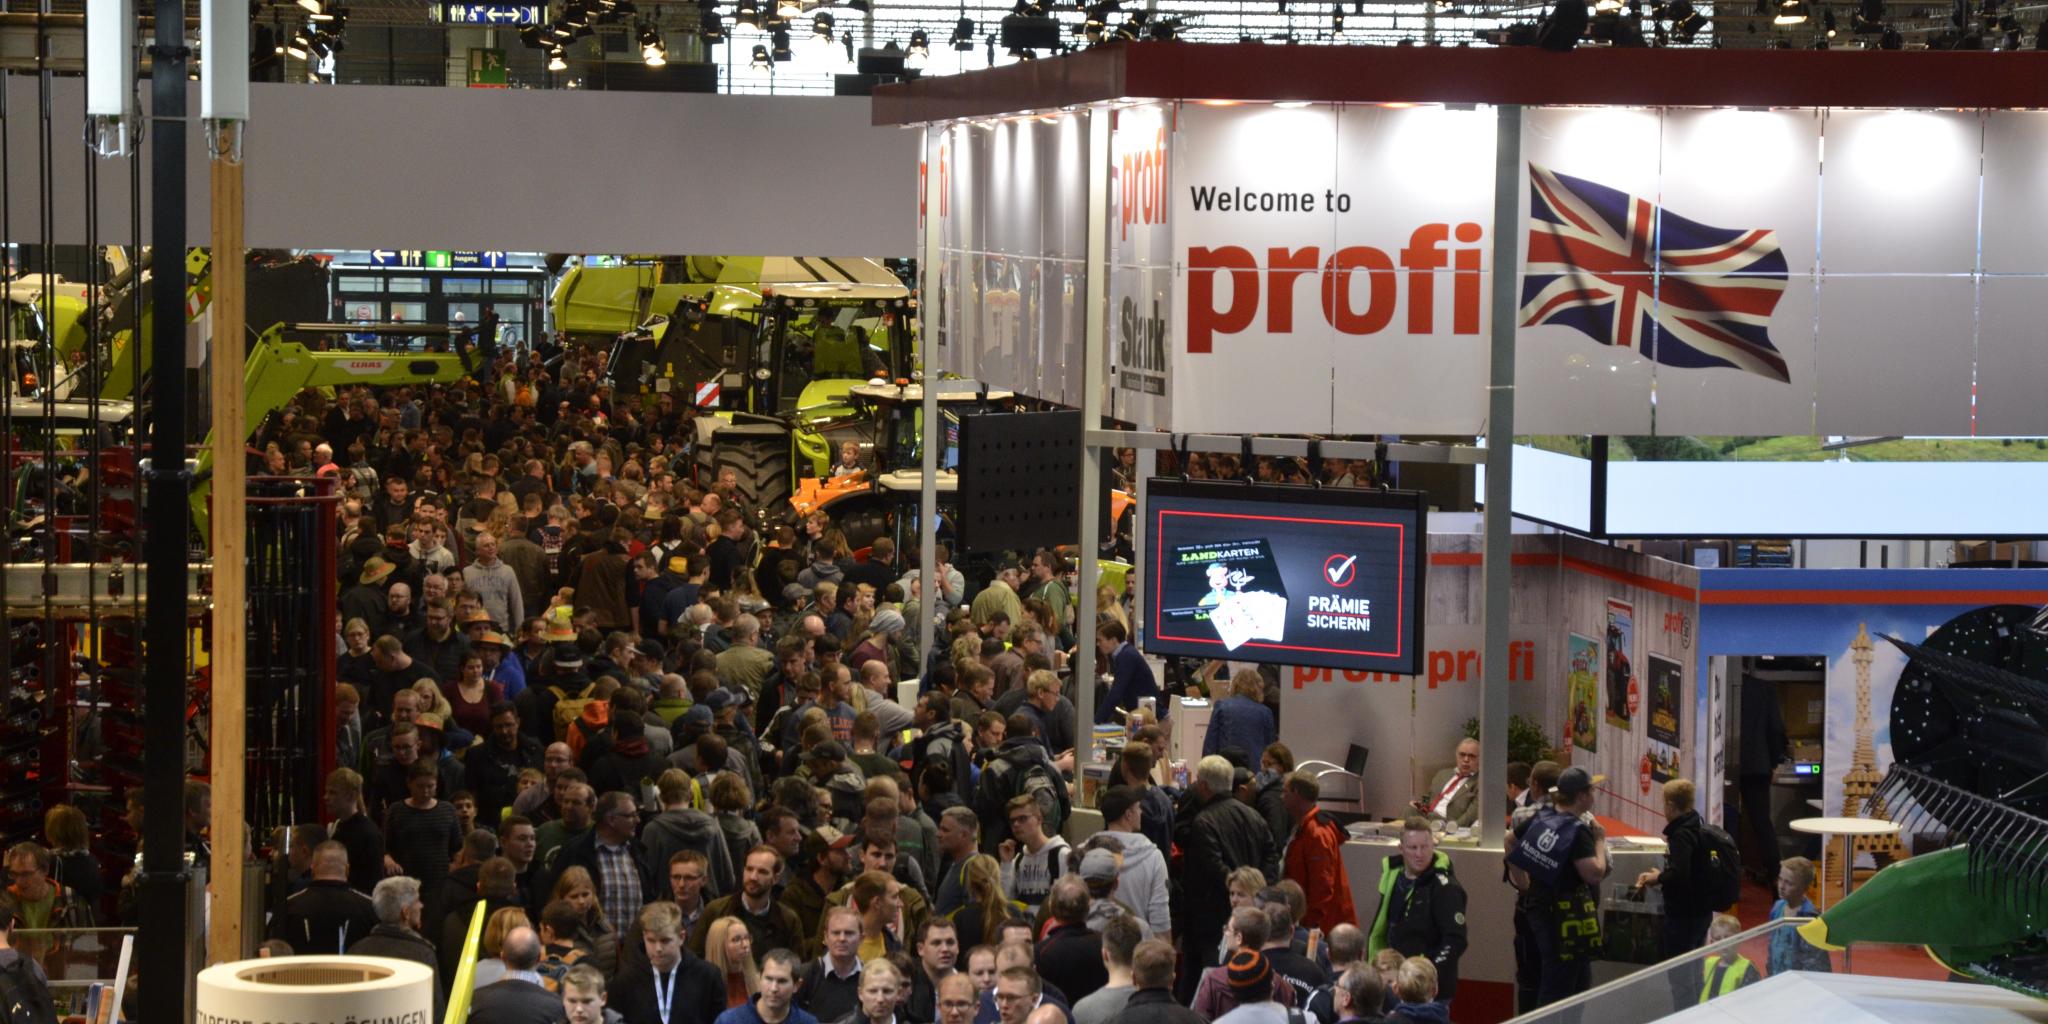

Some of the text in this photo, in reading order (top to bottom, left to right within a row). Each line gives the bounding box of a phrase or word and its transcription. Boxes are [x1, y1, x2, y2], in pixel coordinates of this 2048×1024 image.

[1122, 127, 1168, 241] profi
[1190, 185, 1351, 212] Welcome to
[1187, 222, 1483, 353] profi
[1121, 295, 1166, 373] Stark
[1181, 547, 1260, 562] LANDKARTEN
[1308, 594, 1370, 615] PRÄMIE
[1307, 614, 1371, 632] SICHERN!
[1428, 641, 1535, 689] prfi
[1520, 839, 1560, 869] Husqvarna
